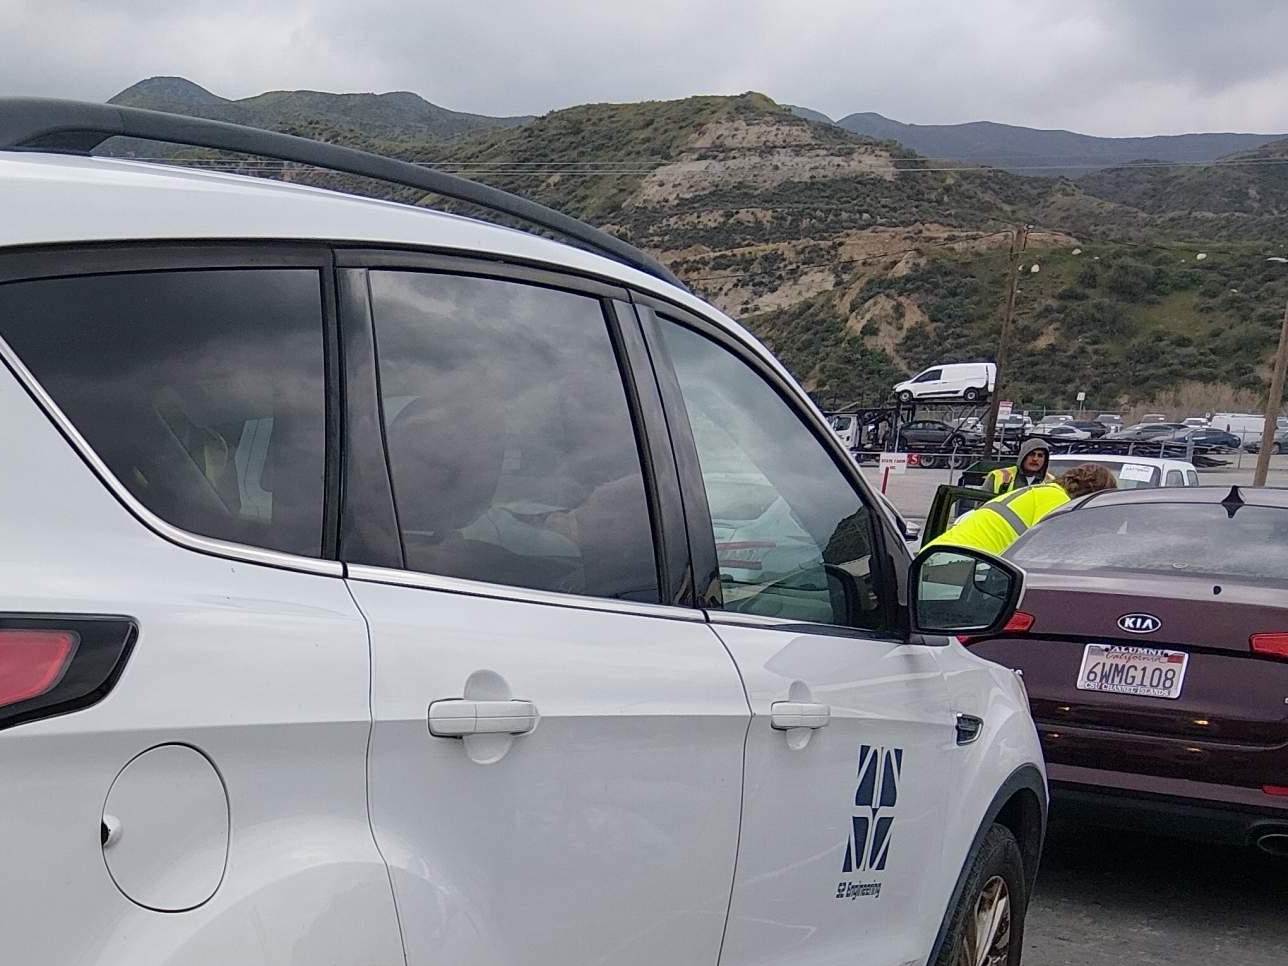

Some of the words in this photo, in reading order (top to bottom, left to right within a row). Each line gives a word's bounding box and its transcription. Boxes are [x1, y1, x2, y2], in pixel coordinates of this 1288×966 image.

[1124, 617, 1153, 630] KIA
[1111, 646, 1165, 656] ALUMNI
[1086, 661, 1177, 689] 6WMG108
[845, 879, 882, 901] Engineering
